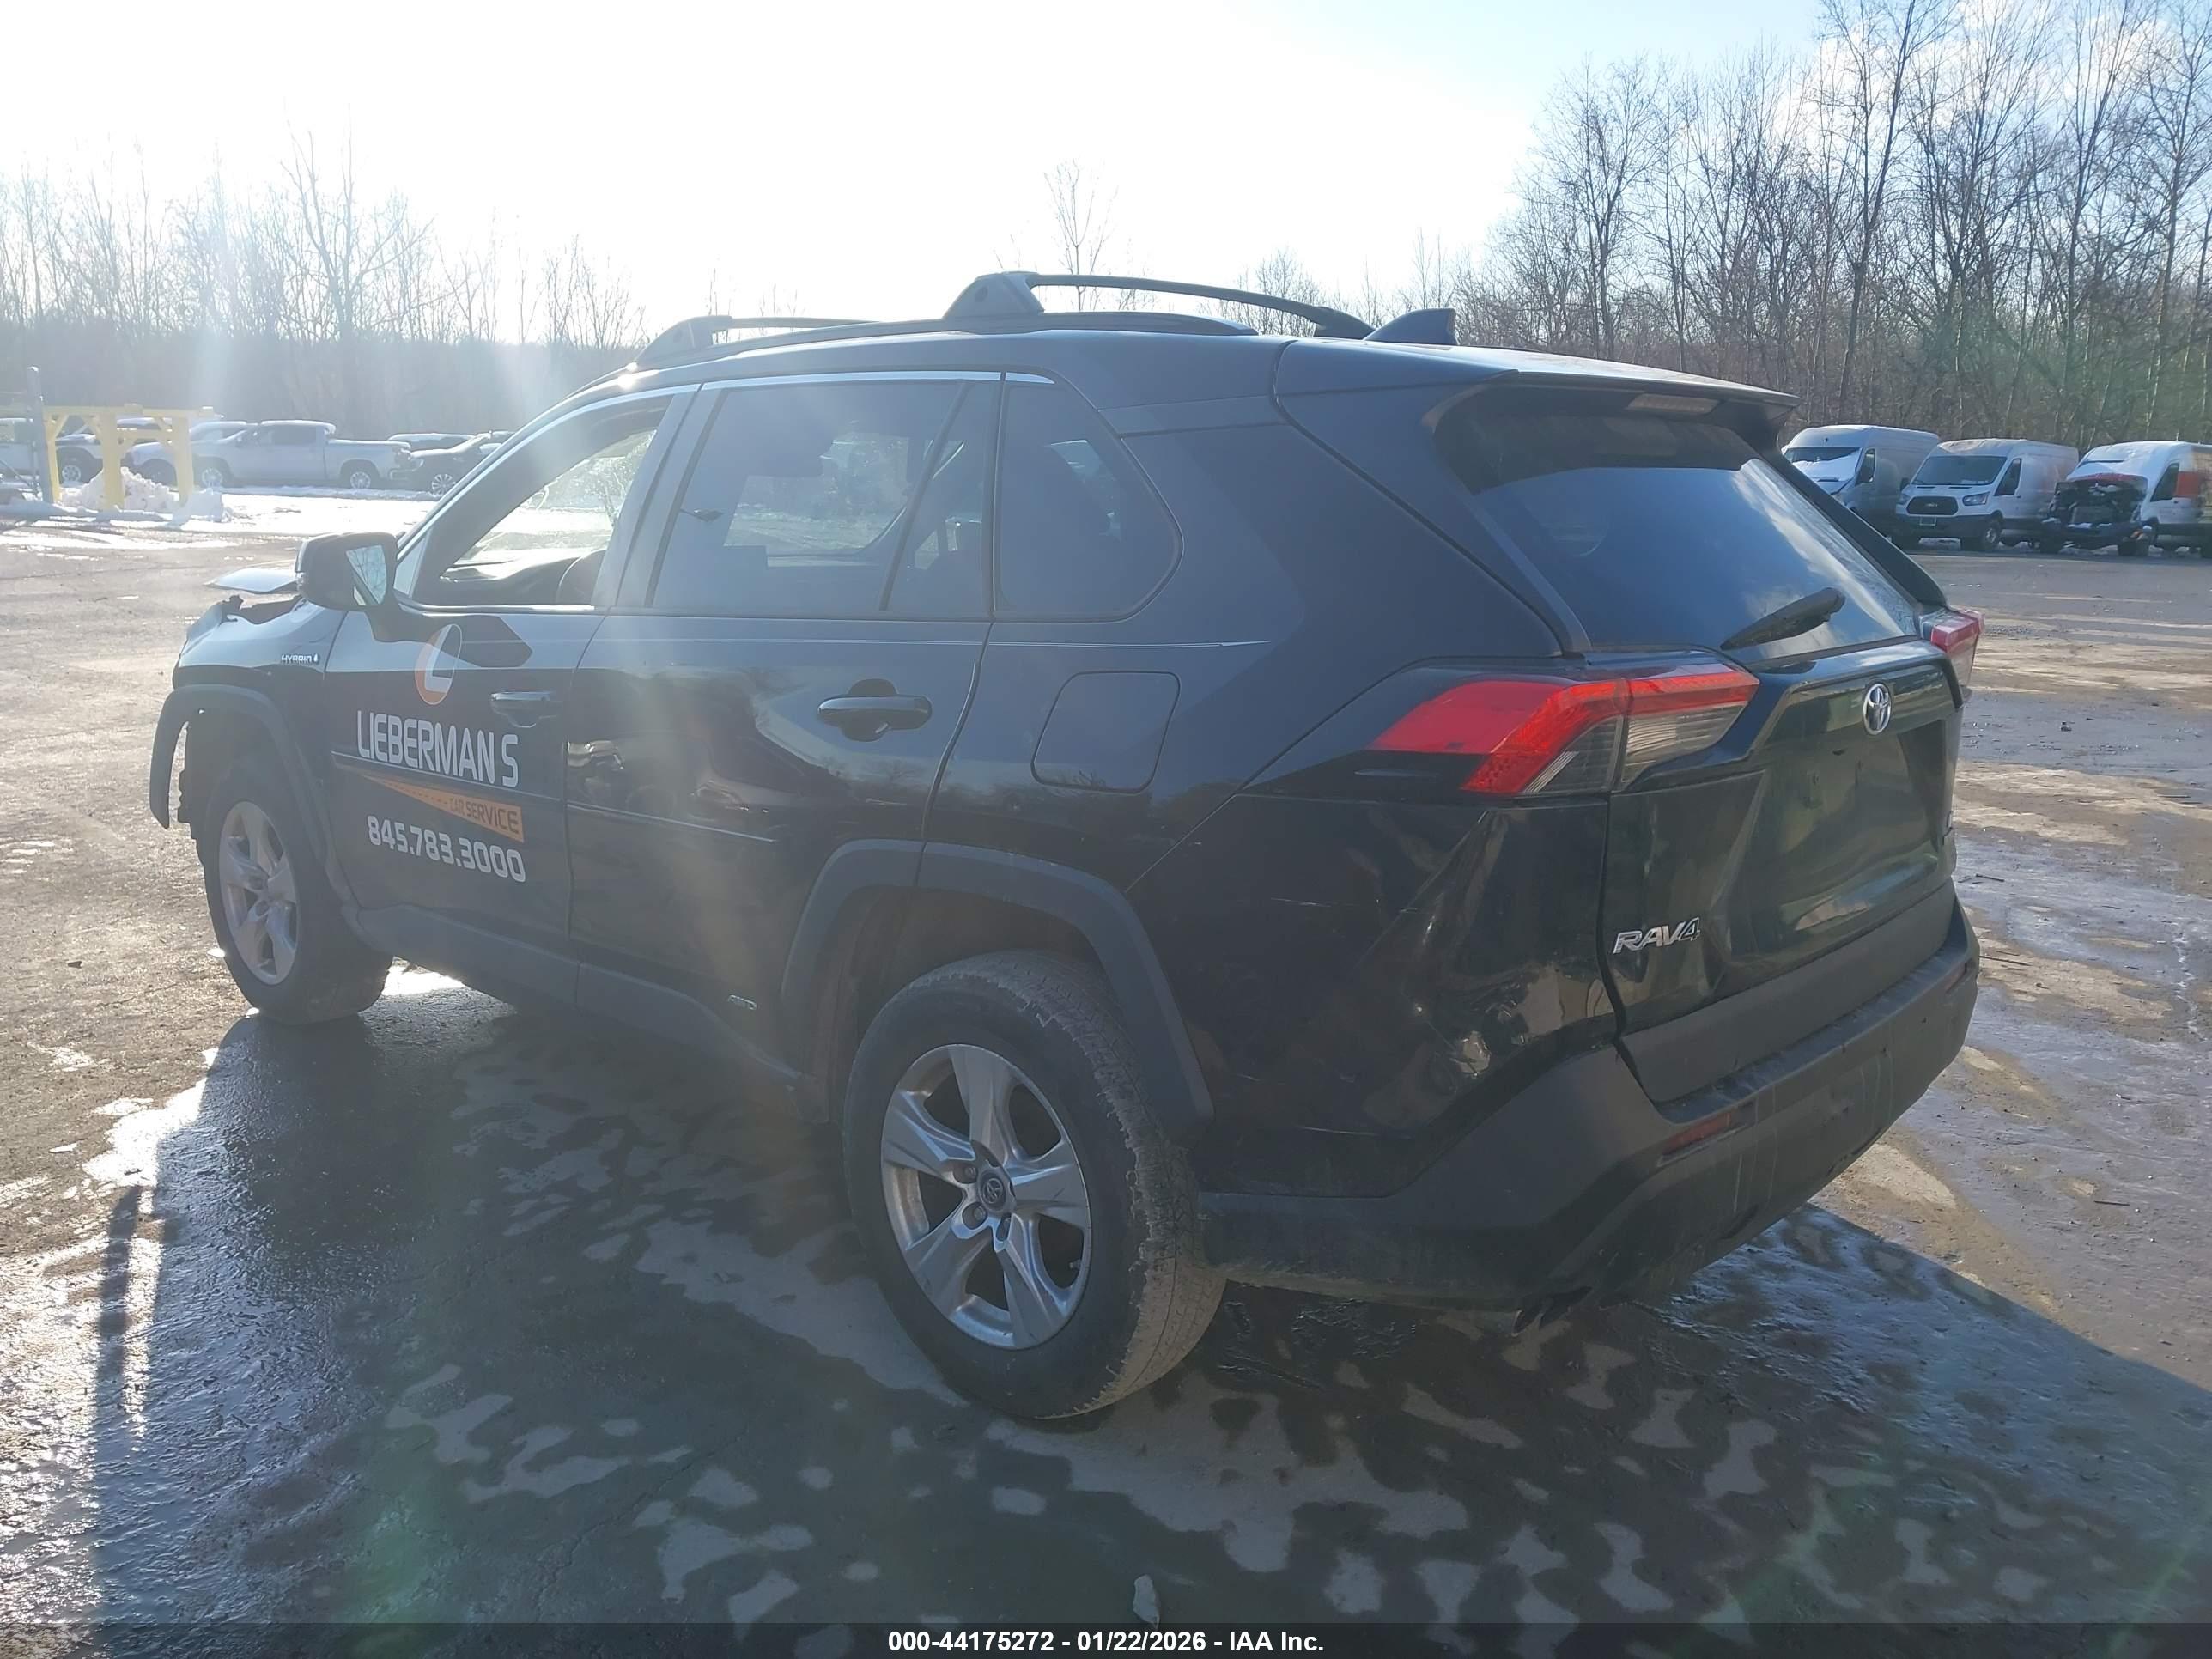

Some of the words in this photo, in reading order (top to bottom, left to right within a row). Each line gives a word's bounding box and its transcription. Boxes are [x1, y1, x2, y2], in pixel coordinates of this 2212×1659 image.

[357, 710, 495, 784] LIEBERMAN
[465, 800, 520, 835] SERVICE
[367, 816, 526, 883] 845.783.3000
[1613, 917, 1701, 954] RAV4
